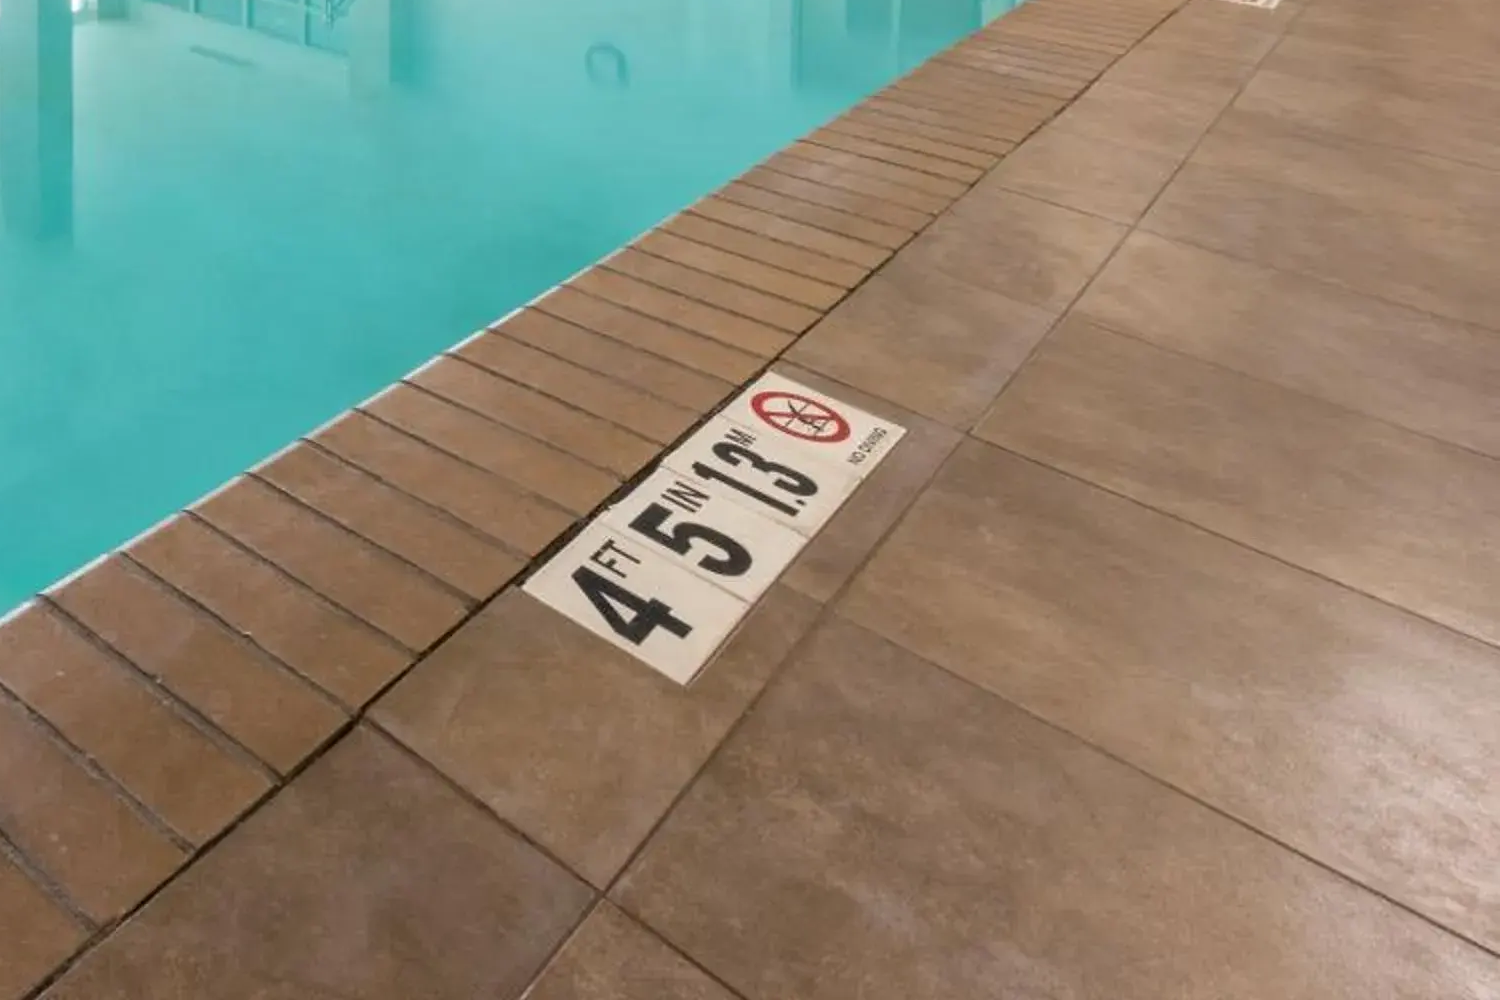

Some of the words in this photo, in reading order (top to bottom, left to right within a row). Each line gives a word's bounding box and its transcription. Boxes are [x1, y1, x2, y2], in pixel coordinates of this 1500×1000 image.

[724, 428, 757, 446] M
[847, 451, 867, 465] NO
[660, 481, 711, 513] IN
[627, 502, 753, 577] 5
[589, 538, 641, 579] FT
[571, 565, 693, 646] 4
